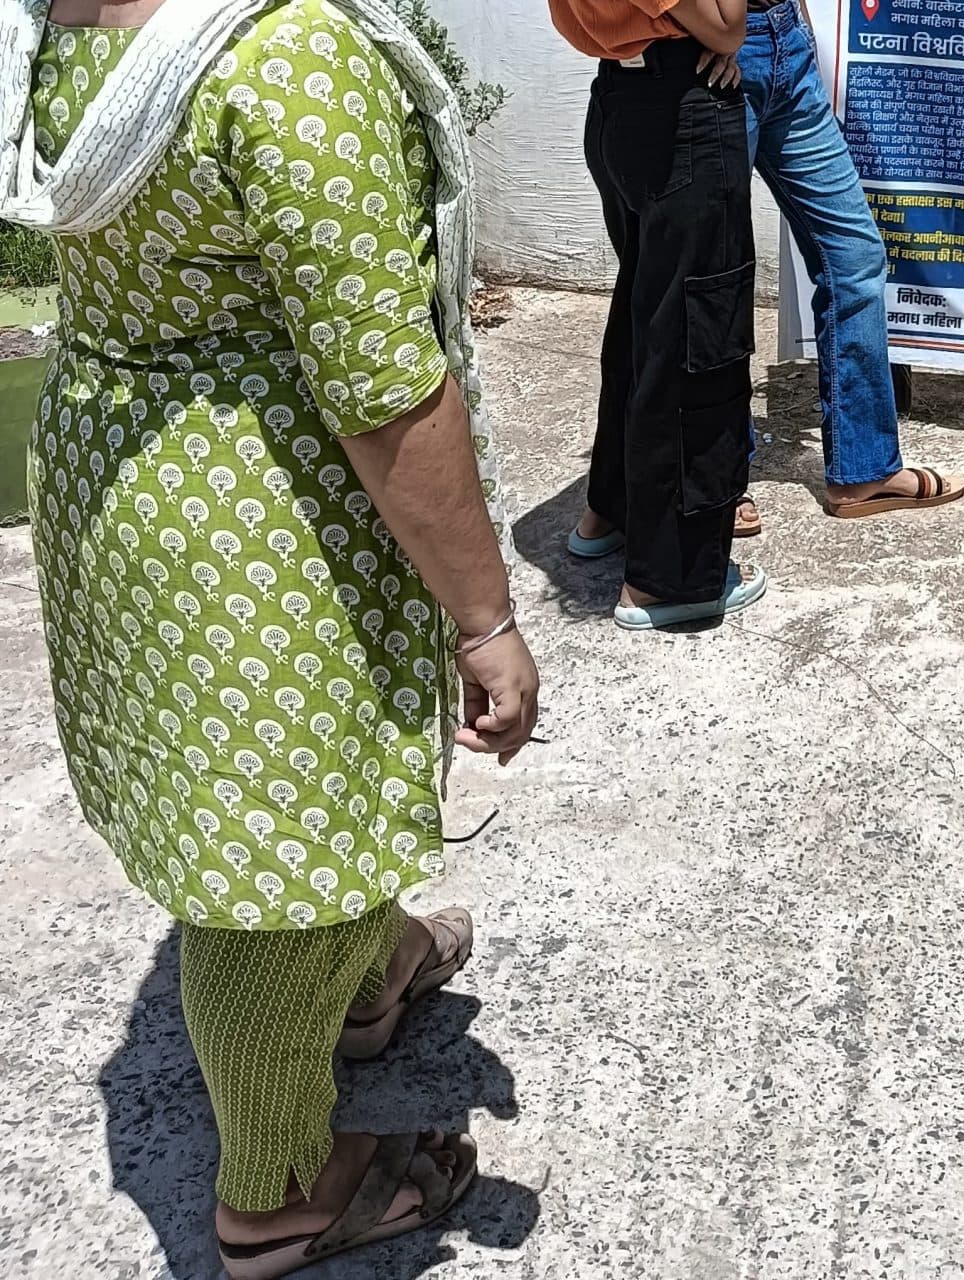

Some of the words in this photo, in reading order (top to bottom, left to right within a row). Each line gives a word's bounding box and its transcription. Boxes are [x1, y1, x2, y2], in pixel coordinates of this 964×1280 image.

[891, 13, 919, 25] मगध
[921, 13, 956, 28] महिला
[858, 32, 909, 51] पटना
[898, 68, 908, 78] जो
[911, 68, 923, 78] कि
[886, 76, 902, 89] और
[870, 99, 882, 109] की
[905, 91, 925, 101] मगध
[927, 92, 953, 104] महिला
[848, 110, 871, 120] केवल
[899, 111, 915, 122] और
[899, 124, 920, 132] चयन
[880, 144, 907, 154] प्रणाली
[908, 145, 919, 155] के
[920, 148, 944, 157] कारण
[923, 157, 945, 168] करने
[946, 160, 958, 170] का
[871, 166, 882, 176] जो
[884, 167, 913, 177] योग्यता
[914, 167, 924, 177] के
[925, 169, 943, 179] साथ
[877, 194, 894, 204] एक
[896, 195, 935, 207] हस्ताक्षर
[937, 197, 953, 208] इस
[889, 246, 900, 258] में
[901, 249, 936, 261] बदलाव
[937, 248, 950, 261] की
[897, 288, 947, 307] निवेदक:
[887, 311, 920, 326] मगध
[922, 311, 961, 329] महिला
